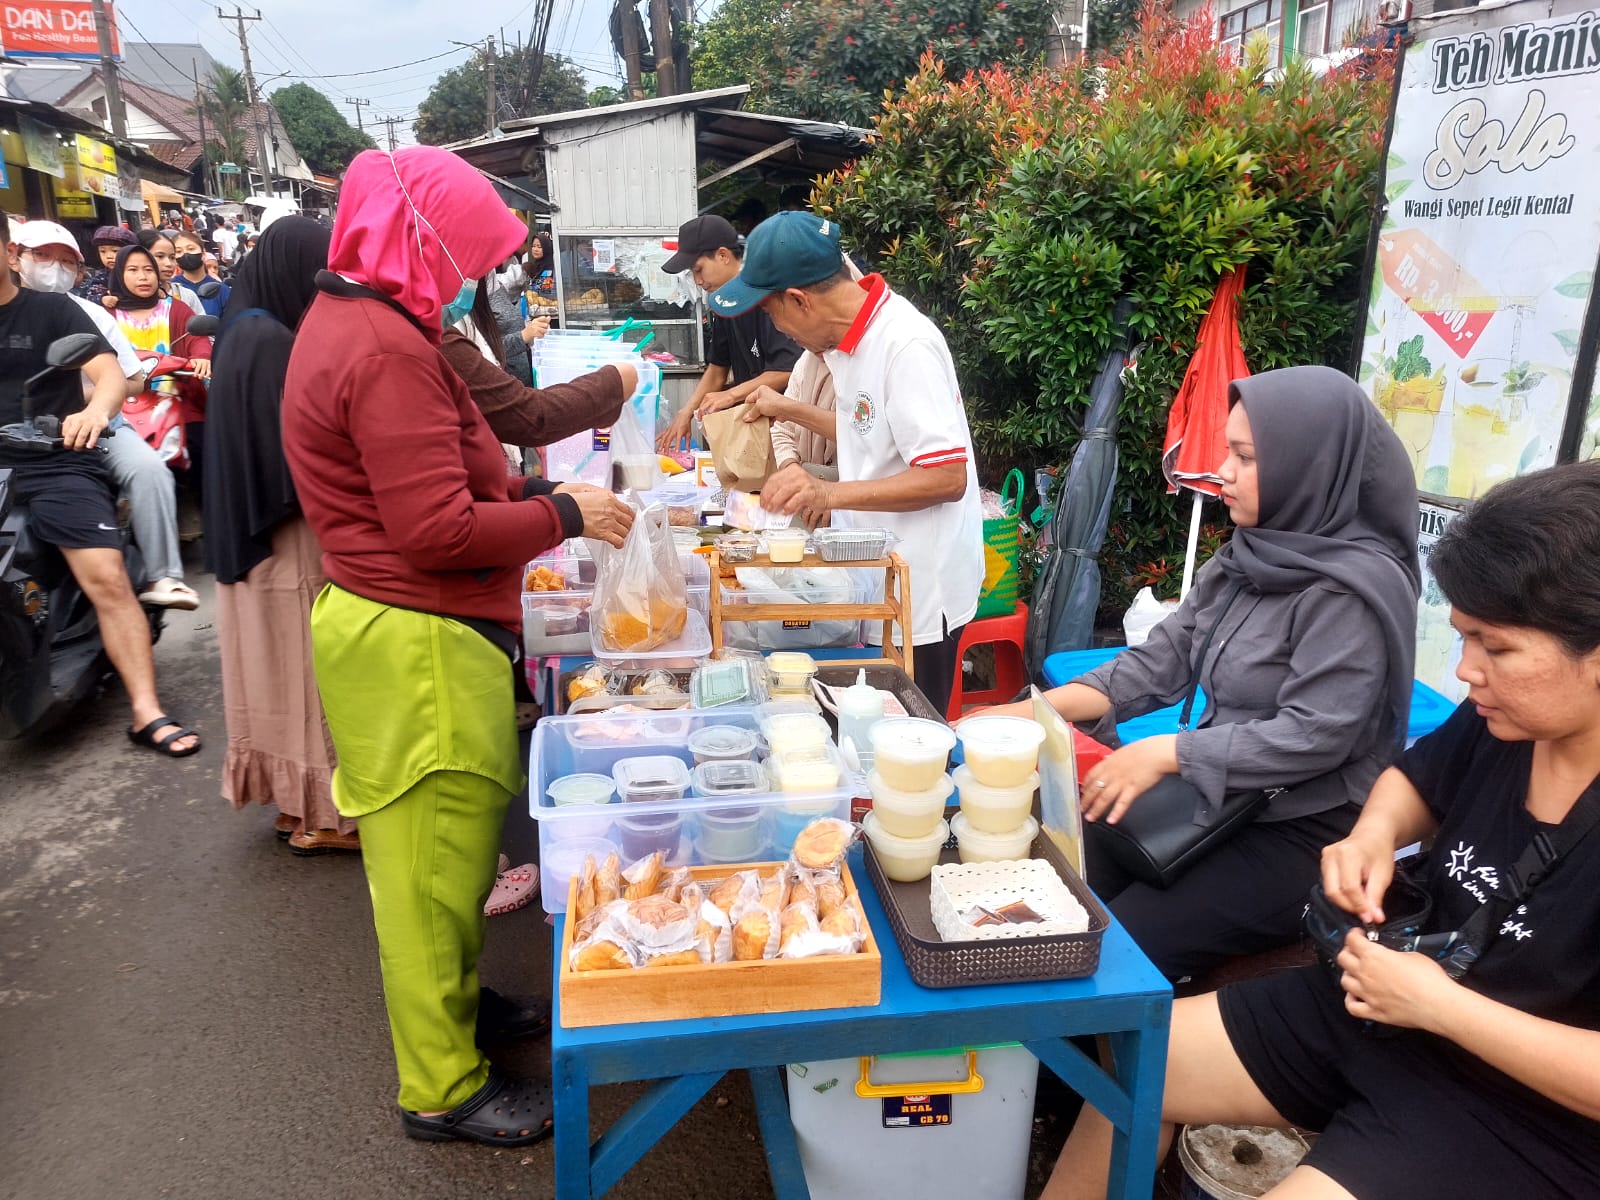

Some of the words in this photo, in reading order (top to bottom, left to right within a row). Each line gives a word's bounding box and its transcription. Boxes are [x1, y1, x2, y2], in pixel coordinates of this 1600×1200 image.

[5, 7, 53, 29] DAN
[62, 9, 96, 31] DA
[33, 33, 70, 44] Healthy
[72, 34, 97, 43] Beau
[1434, 36, 1492, 91] Teh
[1498, 16, 1600, 79] Manis
[1423, 89, 1576, 190] Solo
[1404, 199, 1442, 219] Wangi
[1446, 197, 1485, 219] Sepet
[1486, 195, 1522, 218] Legit
[1524, 193, 1575, 215] Kental
[1394, 253, 1419, 293] Rp.
[1418, 509, 1446, 537] nis
[490, 894, 531, 915] crocs
[901, 1104, 933, 1113] REAL
[936, 1114, 949, 1123] 70
